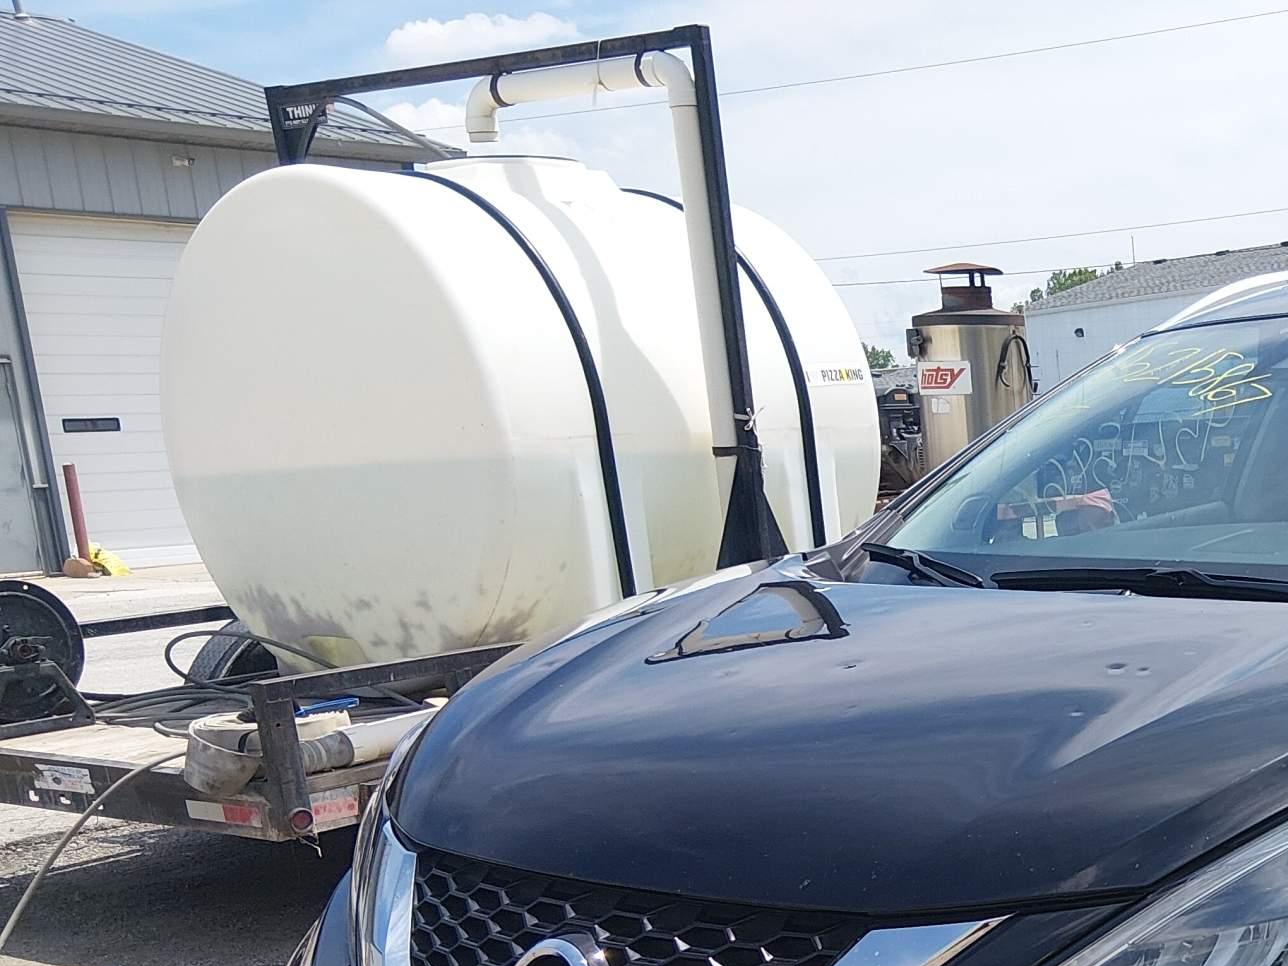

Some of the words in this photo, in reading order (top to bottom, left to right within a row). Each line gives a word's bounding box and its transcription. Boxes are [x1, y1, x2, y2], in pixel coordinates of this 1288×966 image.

[820, 369, 845, 383] PIZZA
[845, 368, 864, 382] KING
[921, 366, 966, 390] hotsy
